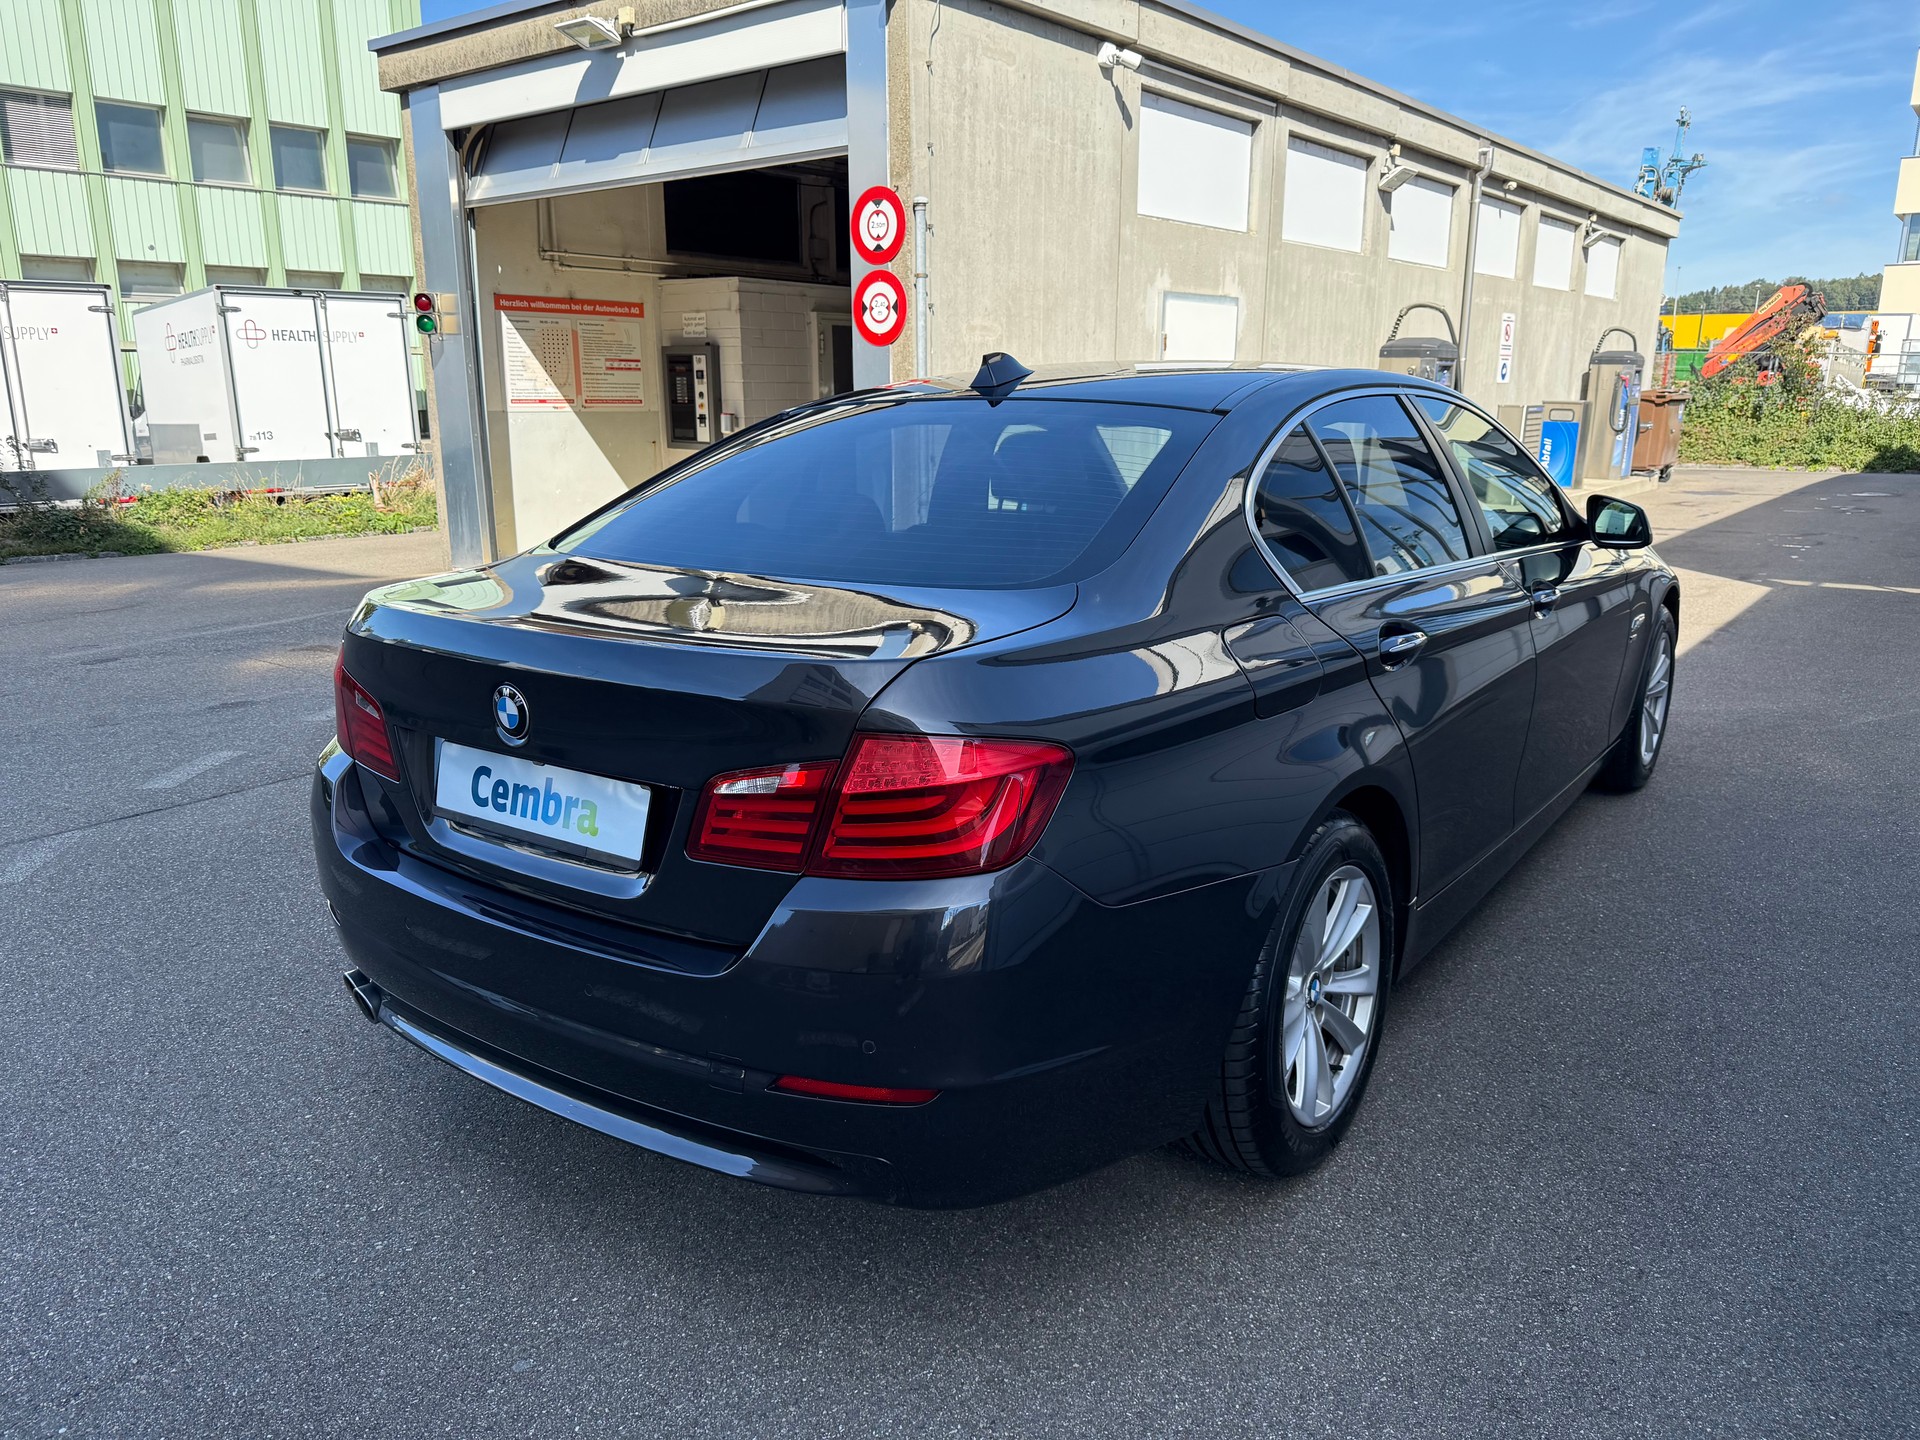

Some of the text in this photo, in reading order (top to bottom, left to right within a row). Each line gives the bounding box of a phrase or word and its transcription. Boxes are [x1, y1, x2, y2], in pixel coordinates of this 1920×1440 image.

[500, 298, 529, 308] Herzlich
[530, 301, 570, 311] willkommen
[571, 303, 582, 311] bei
[583, 304, 594, 312] der
[630, 307, 640, 315] AG
[3, 326, 49, 341] SUPPLY
[271, 329, 358, 344] HEALTH SUPPLY
[256, 430, 274, 441] 113
[1541, 438, 1553, 469] Abfall
[494, 687, 524, 707] BMW
[471, 765, 599, 837] Cembra
